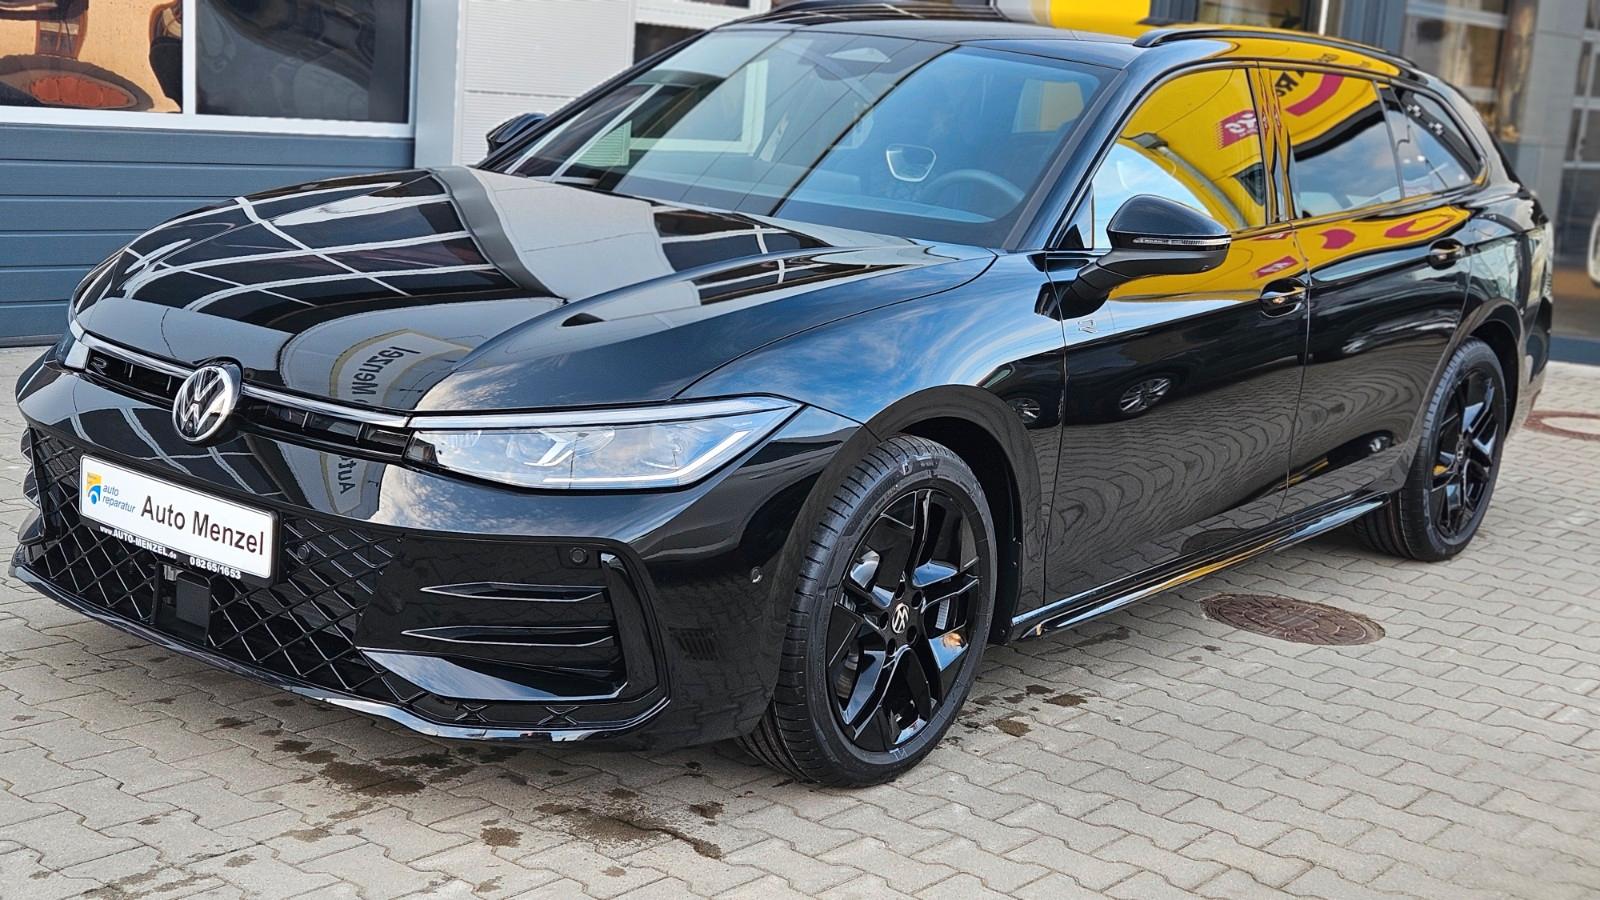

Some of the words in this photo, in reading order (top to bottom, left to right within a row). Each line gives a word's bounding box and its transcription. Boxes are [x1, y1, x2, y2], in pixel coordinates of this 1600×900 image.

[102, 484, 120, 497] auto
[102, 495, 136, 513] reparatur
[141, 495, 186, 531] Auto
[192, 510, 265, 556] Menzel
[99, 525, 178, 560] www.AUTO-MENZEL.de
